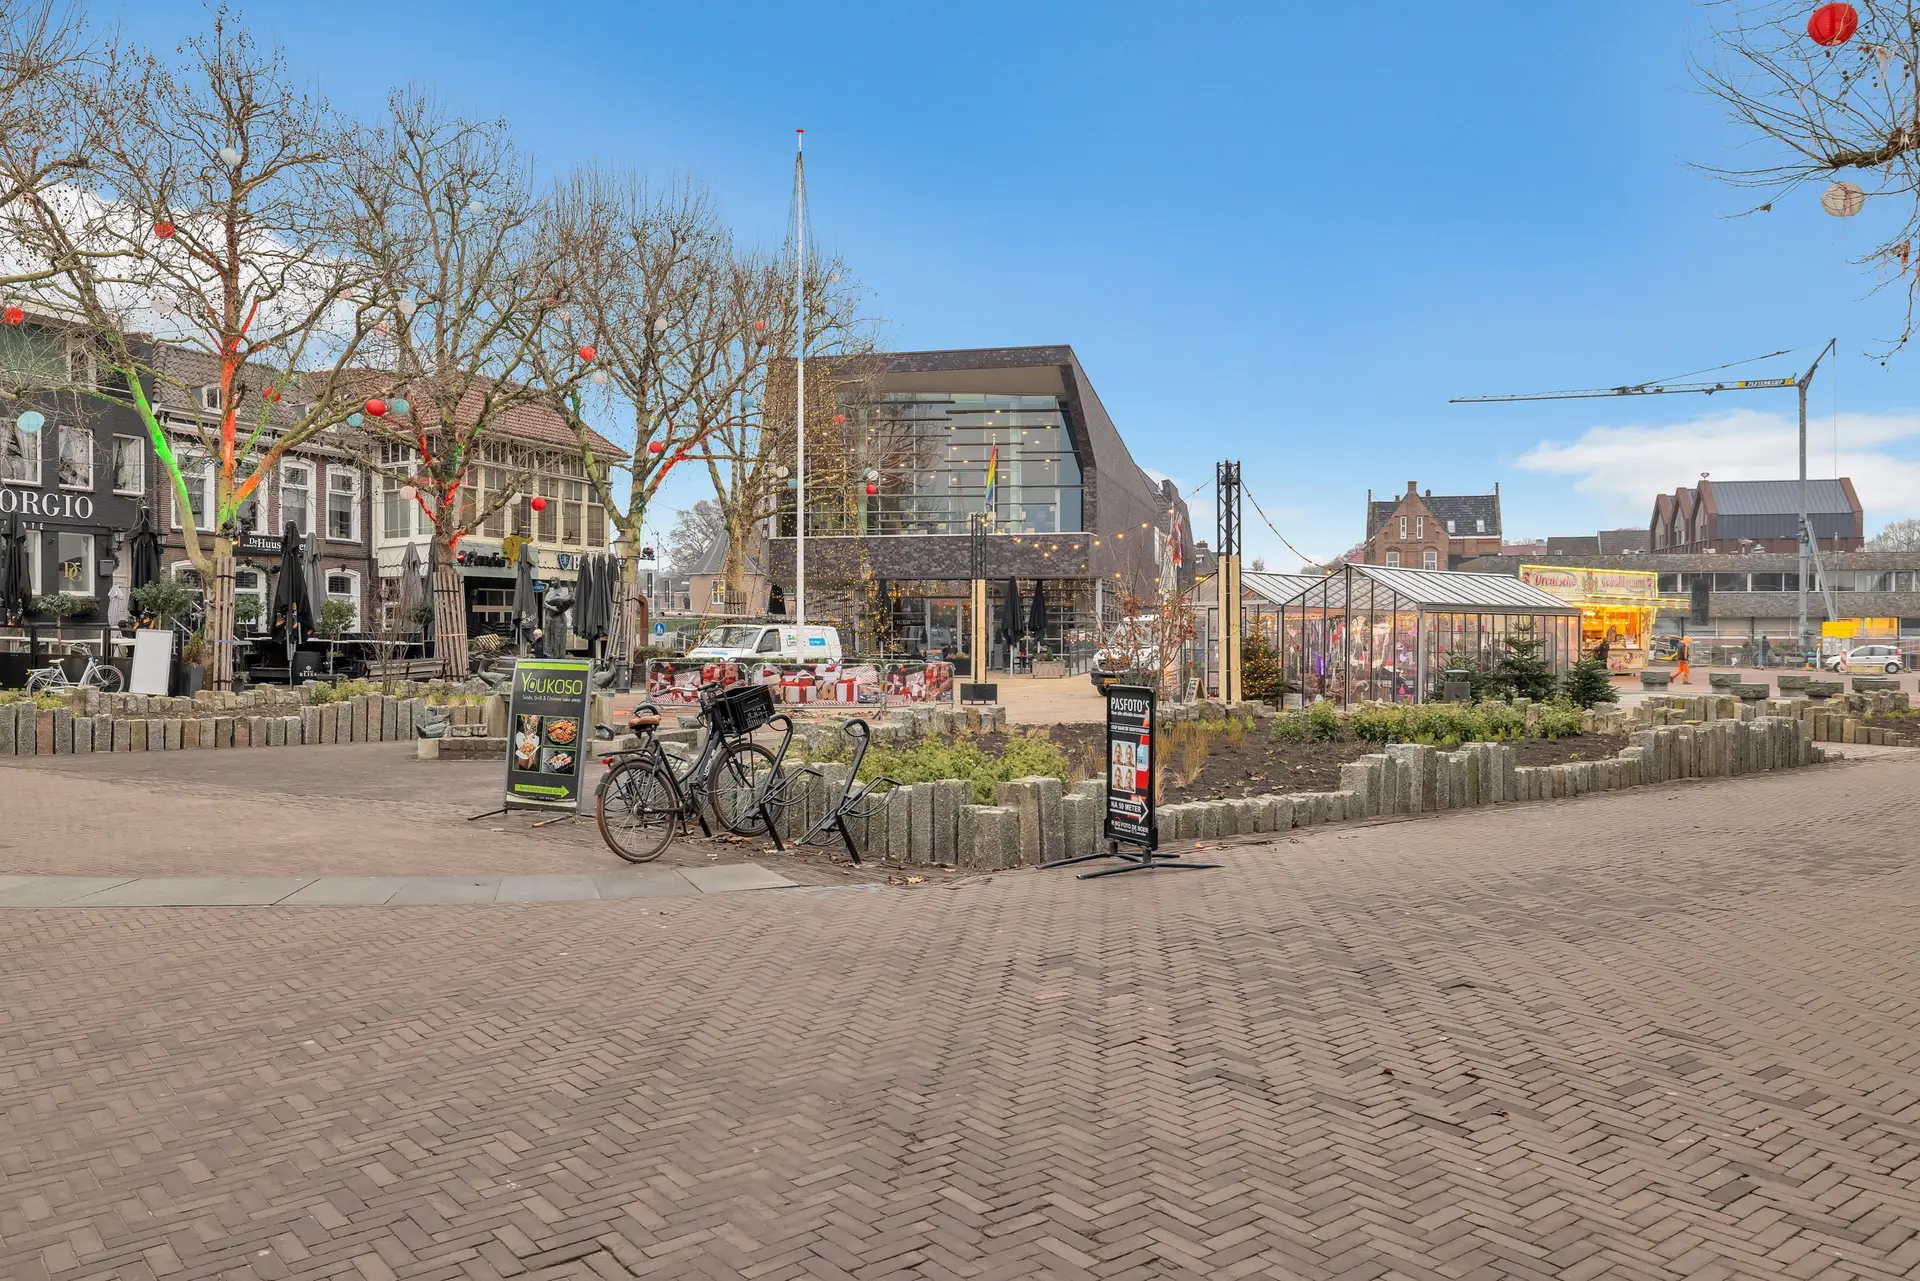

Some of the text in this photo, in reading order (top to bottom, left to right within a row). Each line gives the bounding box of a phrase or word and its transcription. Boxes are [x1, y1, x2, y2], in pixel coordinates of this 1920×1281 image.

[0, 489, 93, 518] ORGIO
[1110, 697, 1150, 713] PASFOTO'S
[1125, 804, 1141, 813] METER
